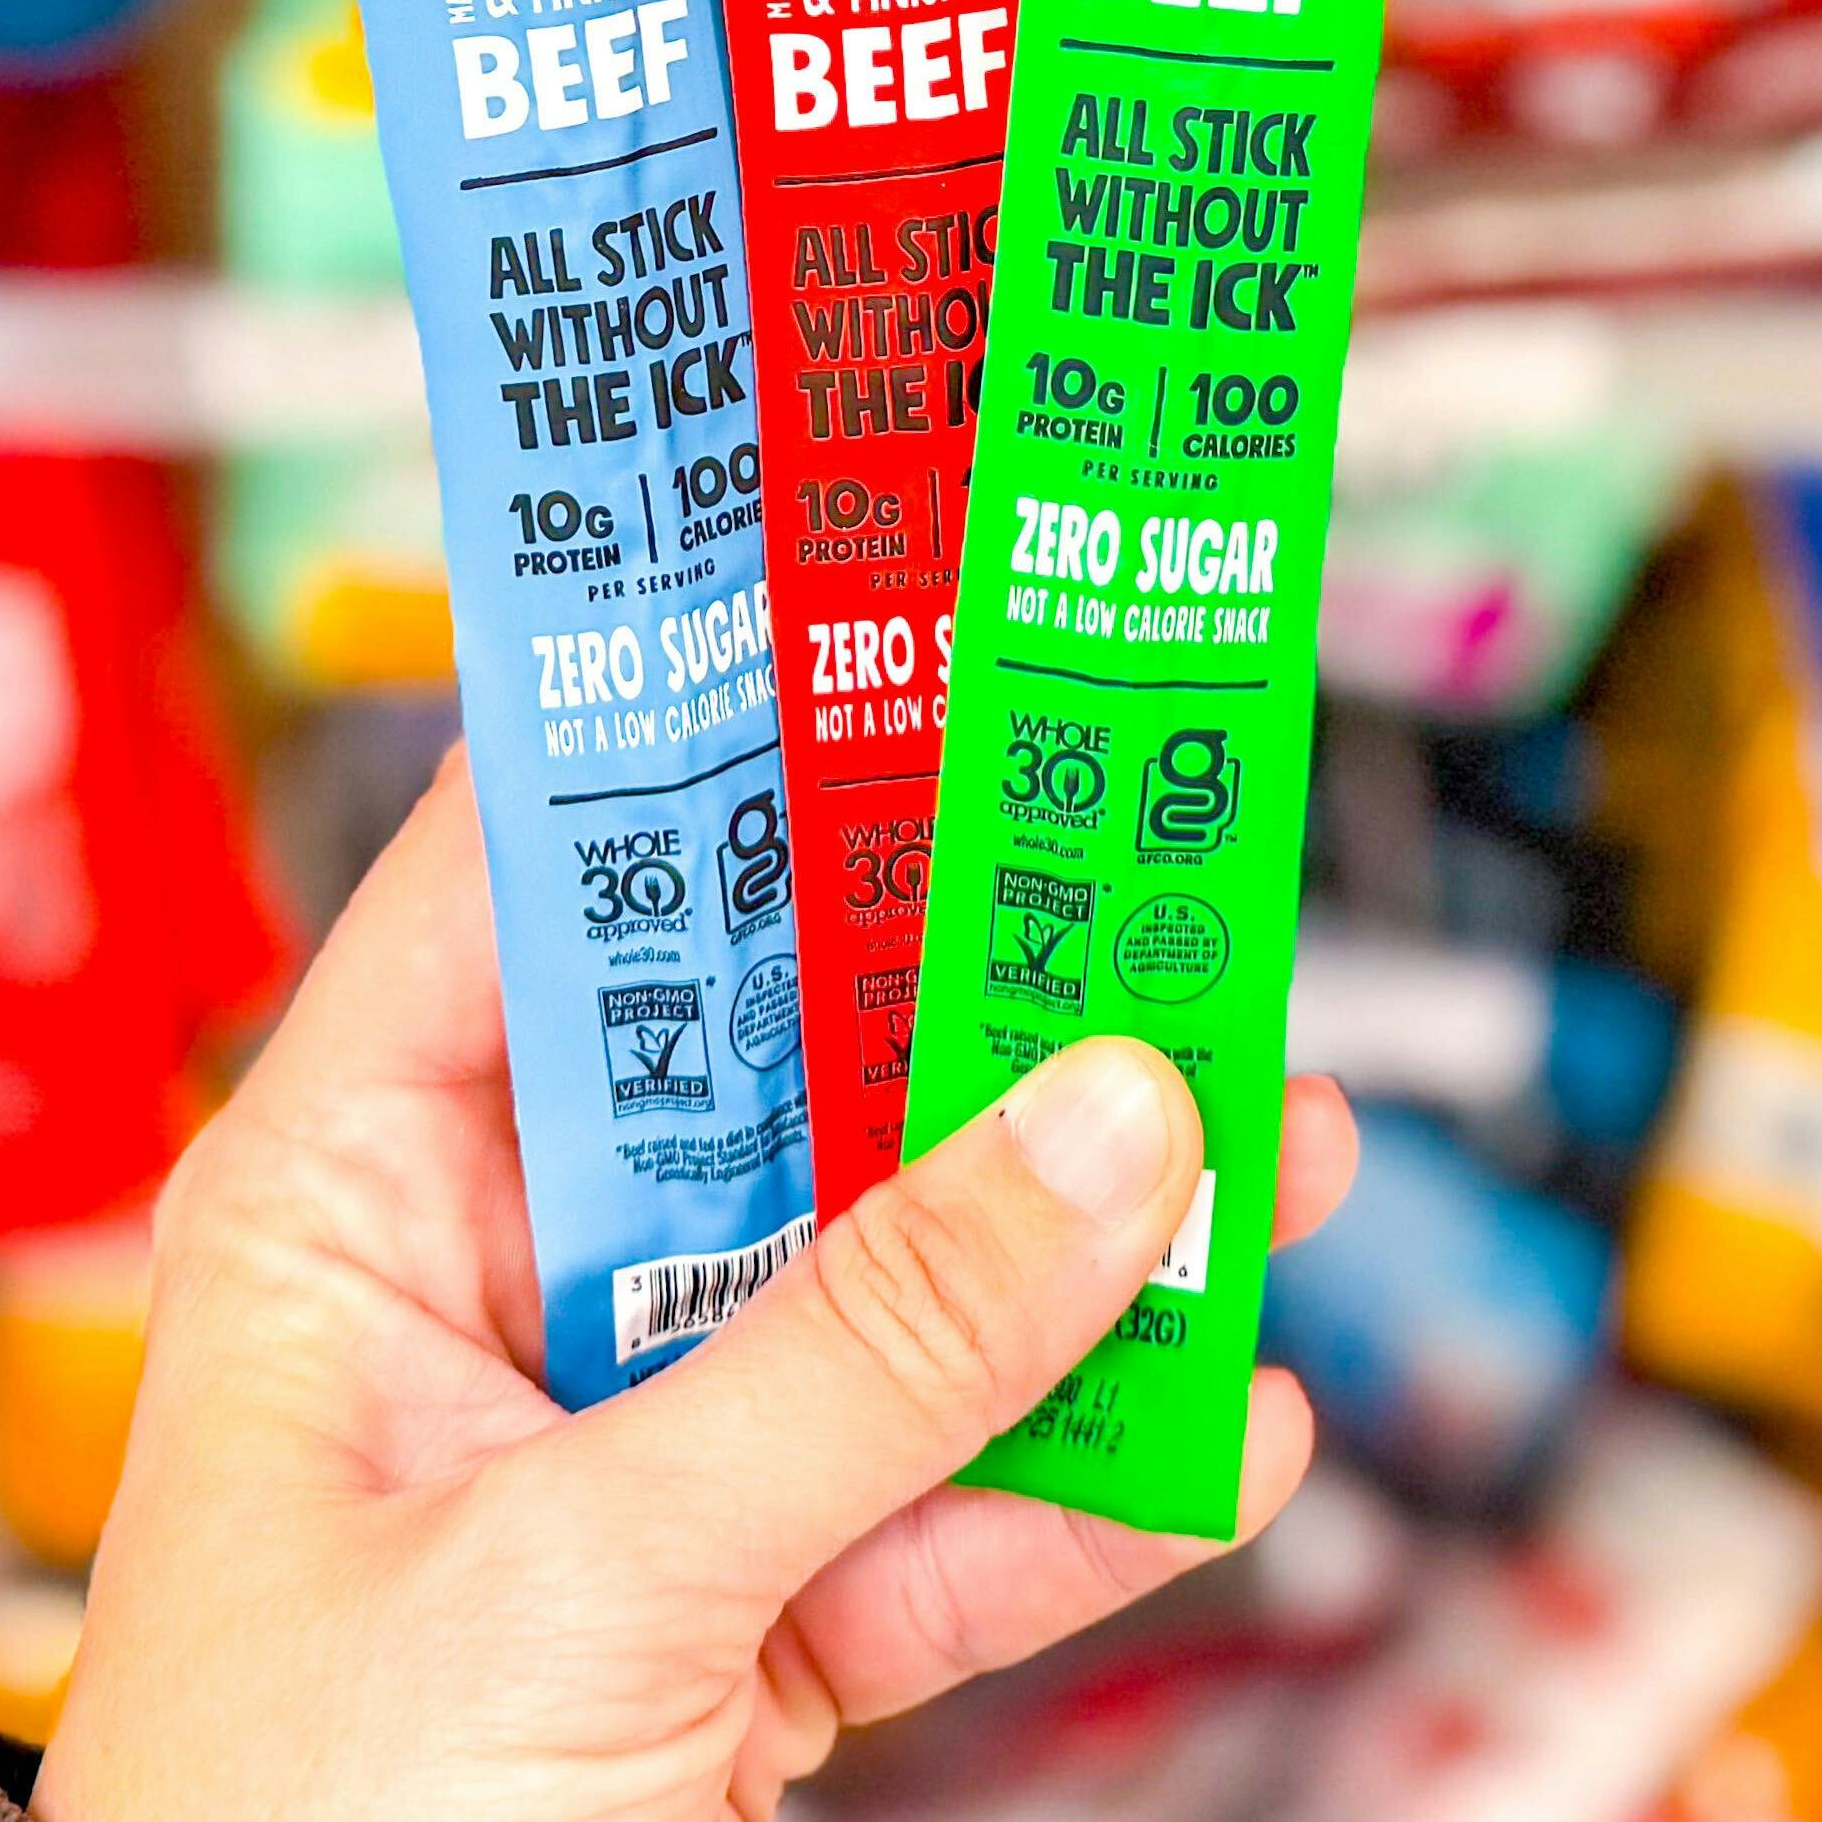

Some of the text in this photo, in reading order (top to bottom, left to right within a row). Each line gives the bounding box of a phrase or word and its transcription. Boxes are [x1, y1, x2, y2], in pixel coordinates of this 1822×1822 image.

[769, 7, 1008, 131] BEEF
[1060, 93, 1318, 177] ALL STICK
[1055, 167, 1309, 253] WITHOUT
[490, 190, 724, 299] ALL STICK
[794, 205, 999, 289] ALL STIC
[1047, 240, 1175, 326] THE
[489, 264, 729, 372] WITHOUT
[792, 279, 992, 361] WITHO
[500, 370, 637, 450] THE
[798, 364, 930, 440] THE
[1190, 373, 1299, 426] 100
[1017, 409, 1296, 460] PROTEIN CALORIES
[672, 442, 760, 518] 100
[1082, 460, 1218, 491] PER SERVING
[514, 499, 763, 577] PROTEIN CALORIE
[798, 533, 906, 563] PROTEIN
[1010, 496, 1278, 595] ZERO SUGAR
[588, 558, 715, 602] PER SERVING
[871, 571, 907, 590] PER
[1006, 585, 1270, 644] NOT A LOW CALORIE SNACK
[531, 626, 644, 709] ZERO
[808, 615, 915, 696] ZERO
[545, 664, 776, 757] NOT A LOW CALORIE SNAC
[815, 703, 854, 743] NOT
[864, 701, 876, 737] A
[884, 694, 923, 736] LOW
[1010, 710, 1111, 754] WHOLE
[1002, 740, 1105, 813] 30
[1000, 798, 1098, 830] approved
[574, 829, 682, 867] WHOLE
[581, 857, 686, 923] 30
[1002, 888, 1086, 920] PROJECT
[1154, 904, 1195, 922] U.S.
[586, 913, 688, 943] approved
[995, 964, 1076, 996] VERIFIED
[610, 1004, 694, 1025] PROJECT
[620, 1078, 703, 1097] VERIFIED
